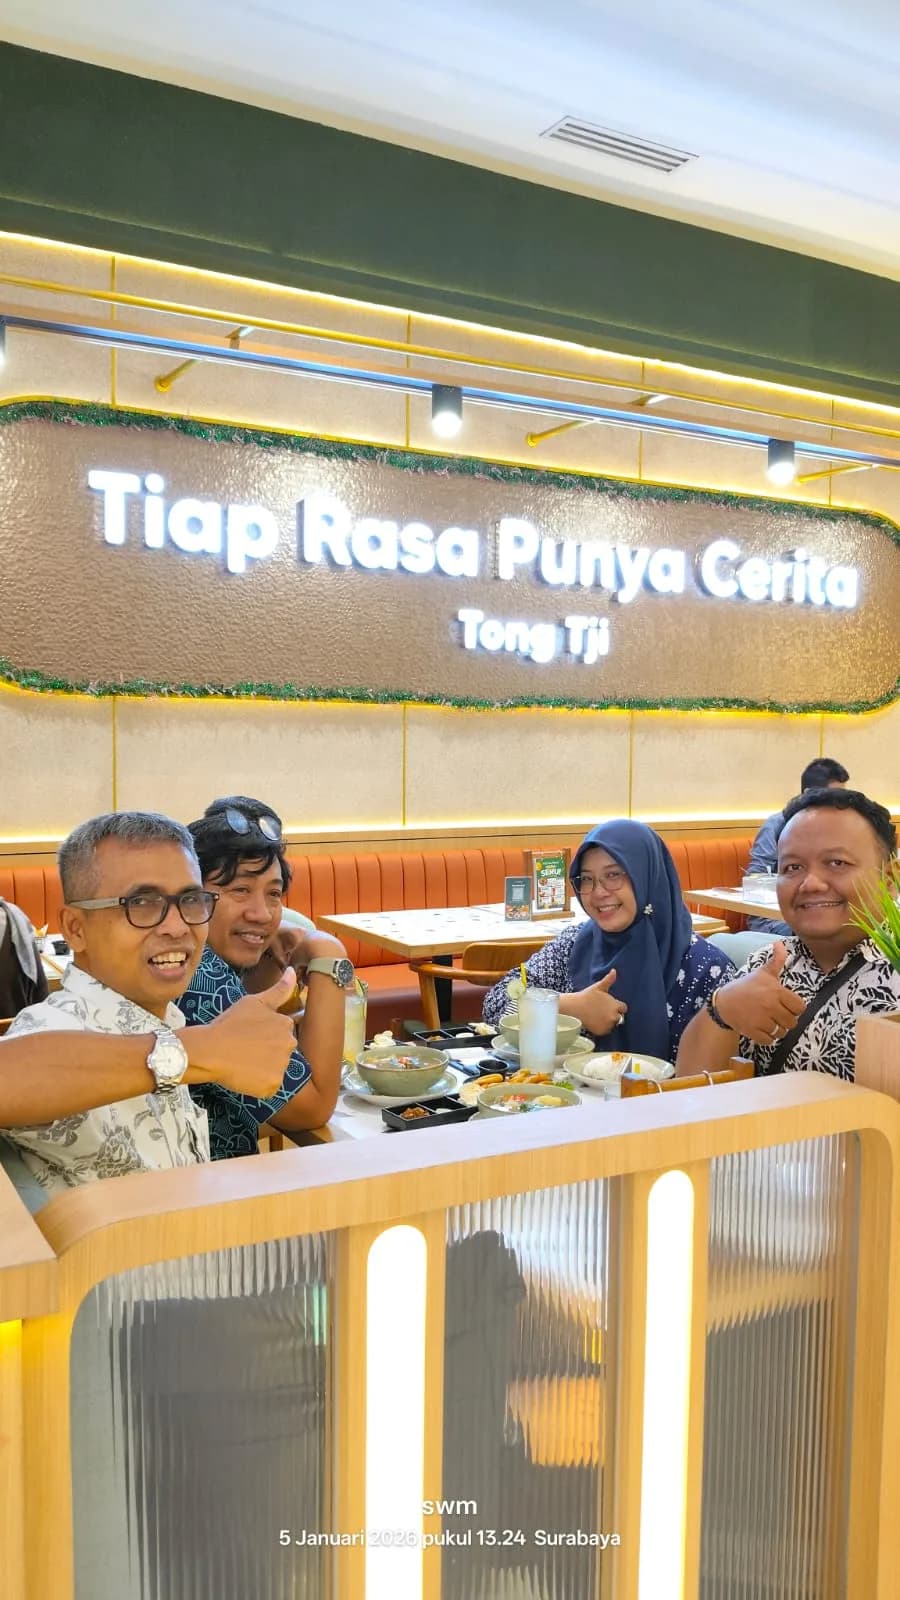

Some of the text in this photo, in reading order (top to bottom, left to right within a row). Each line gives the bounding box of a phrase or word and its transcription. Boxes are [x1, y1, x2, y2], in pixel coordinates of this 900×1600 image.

[87, 469, 859, 609] Tiap Rasa Punya Cerita
[457, 608, 610, 665] Tong Tji
